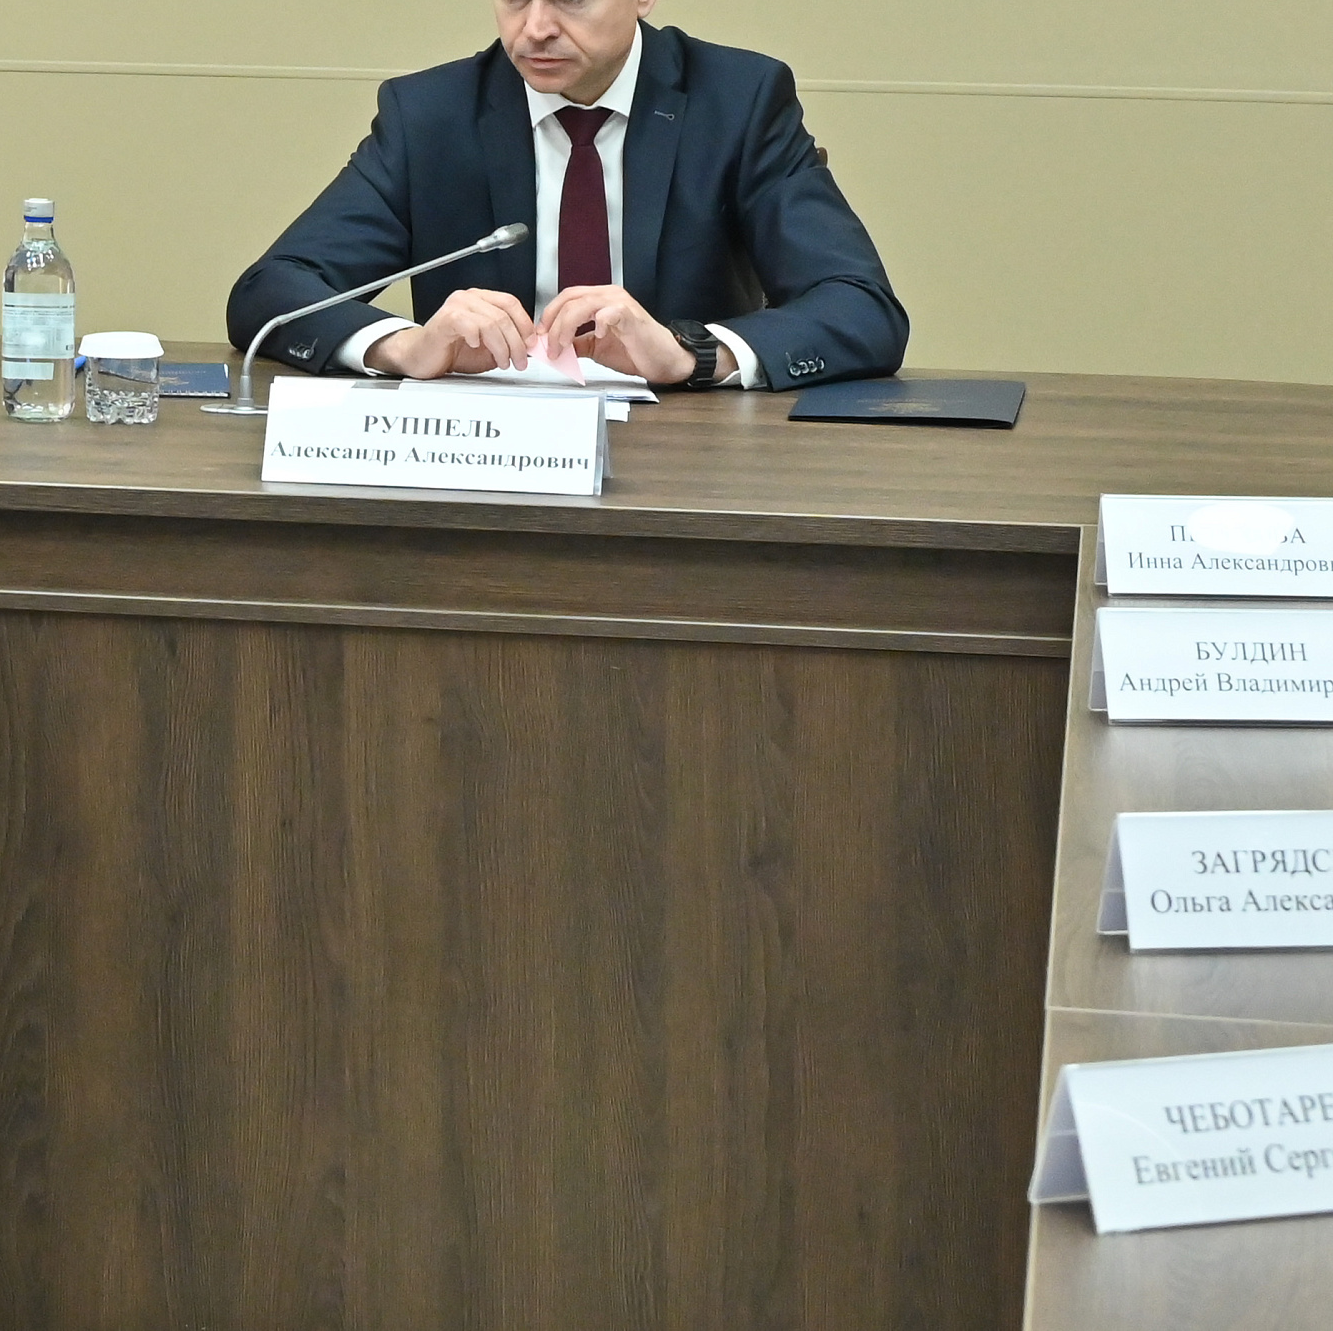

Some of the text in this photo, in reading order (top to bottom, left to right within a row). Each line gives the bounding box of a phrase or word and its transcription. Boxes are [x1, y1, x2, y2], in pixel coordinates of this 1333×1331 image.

[363, 414, 502, 439] РУППЕЛЬ
[270, 440, 590, 472] Александр Александрович
[1127, 551, 1333, 576] Инна Александров
[1194, 641, 1309, 666] БУЛДИН
[1119, 672, 1333, 698] Андрей Владимир
[1191, 848, 1333, 878] ЗАГРЯДС
[1150, 889, 1232, 915] Ольга
[1132, 1143, 1333, 1185] Евгений Серг
